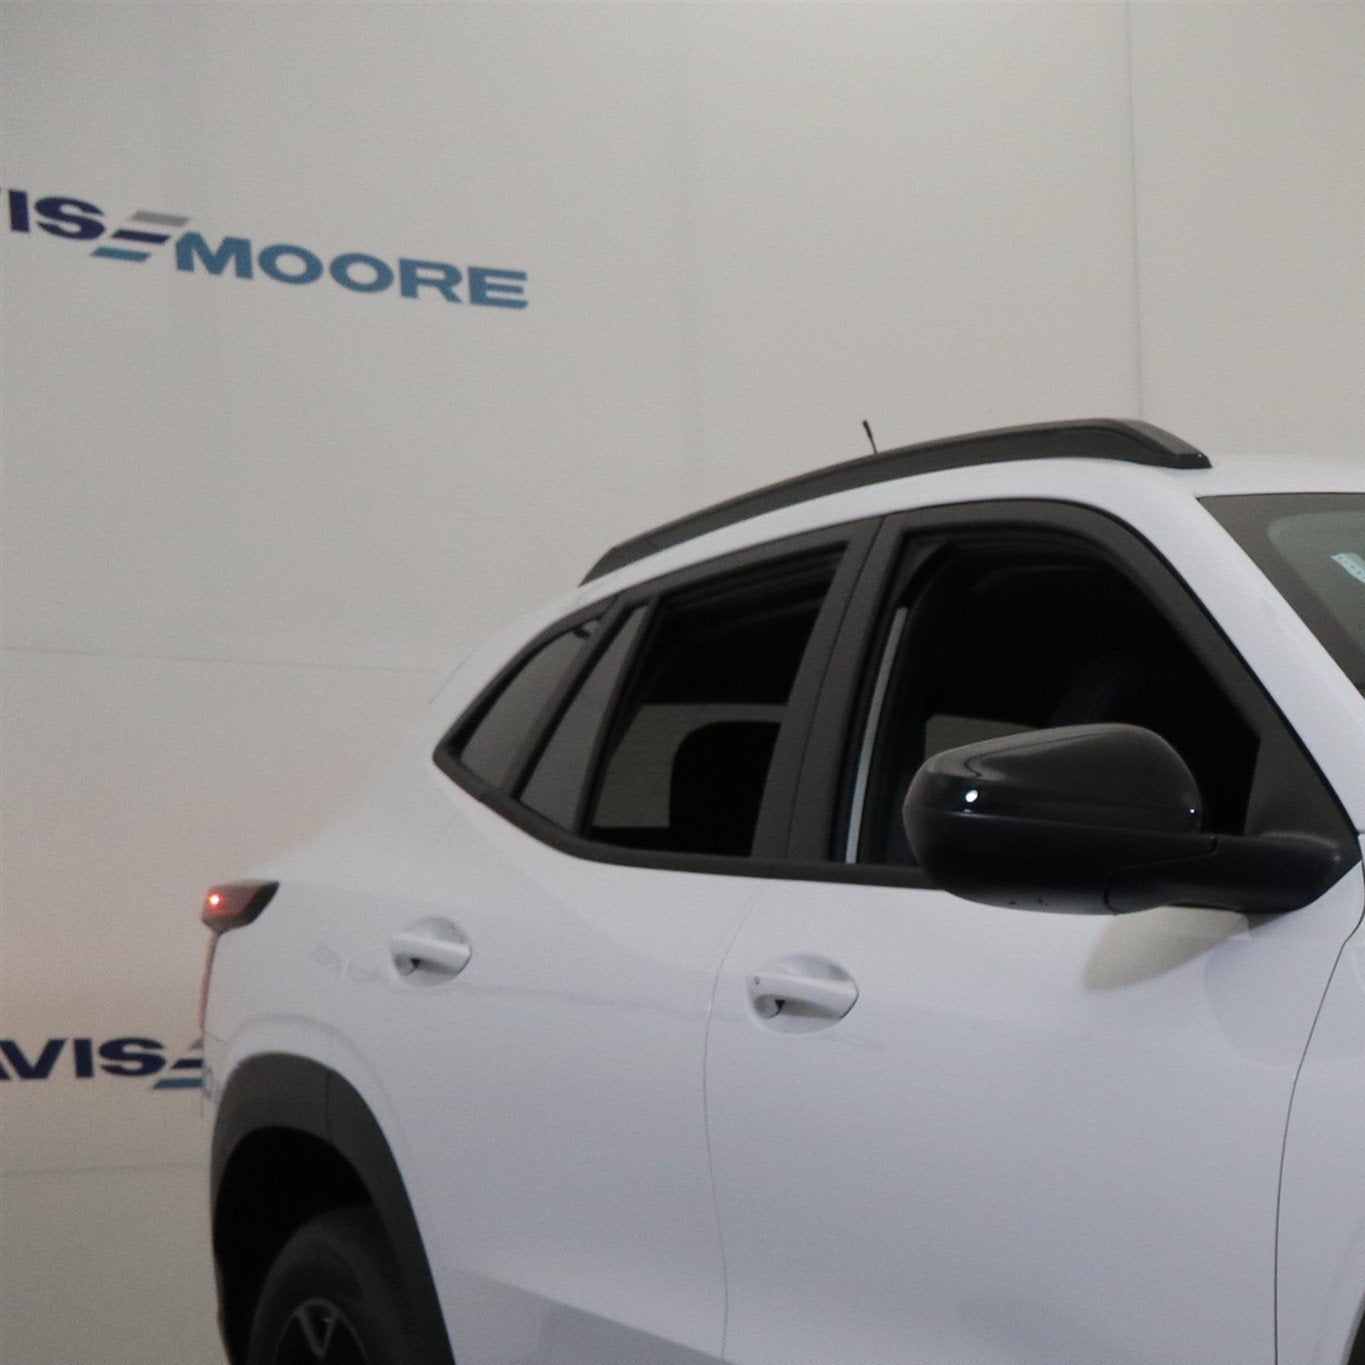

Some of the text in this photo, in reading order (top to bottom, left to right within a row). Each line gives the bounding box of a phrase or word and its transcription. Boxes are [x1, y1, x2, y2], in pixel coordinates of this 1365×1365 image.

[0, 186, 529, 310] IS MOORE
[0, 1036, 168, 1083] VIS
